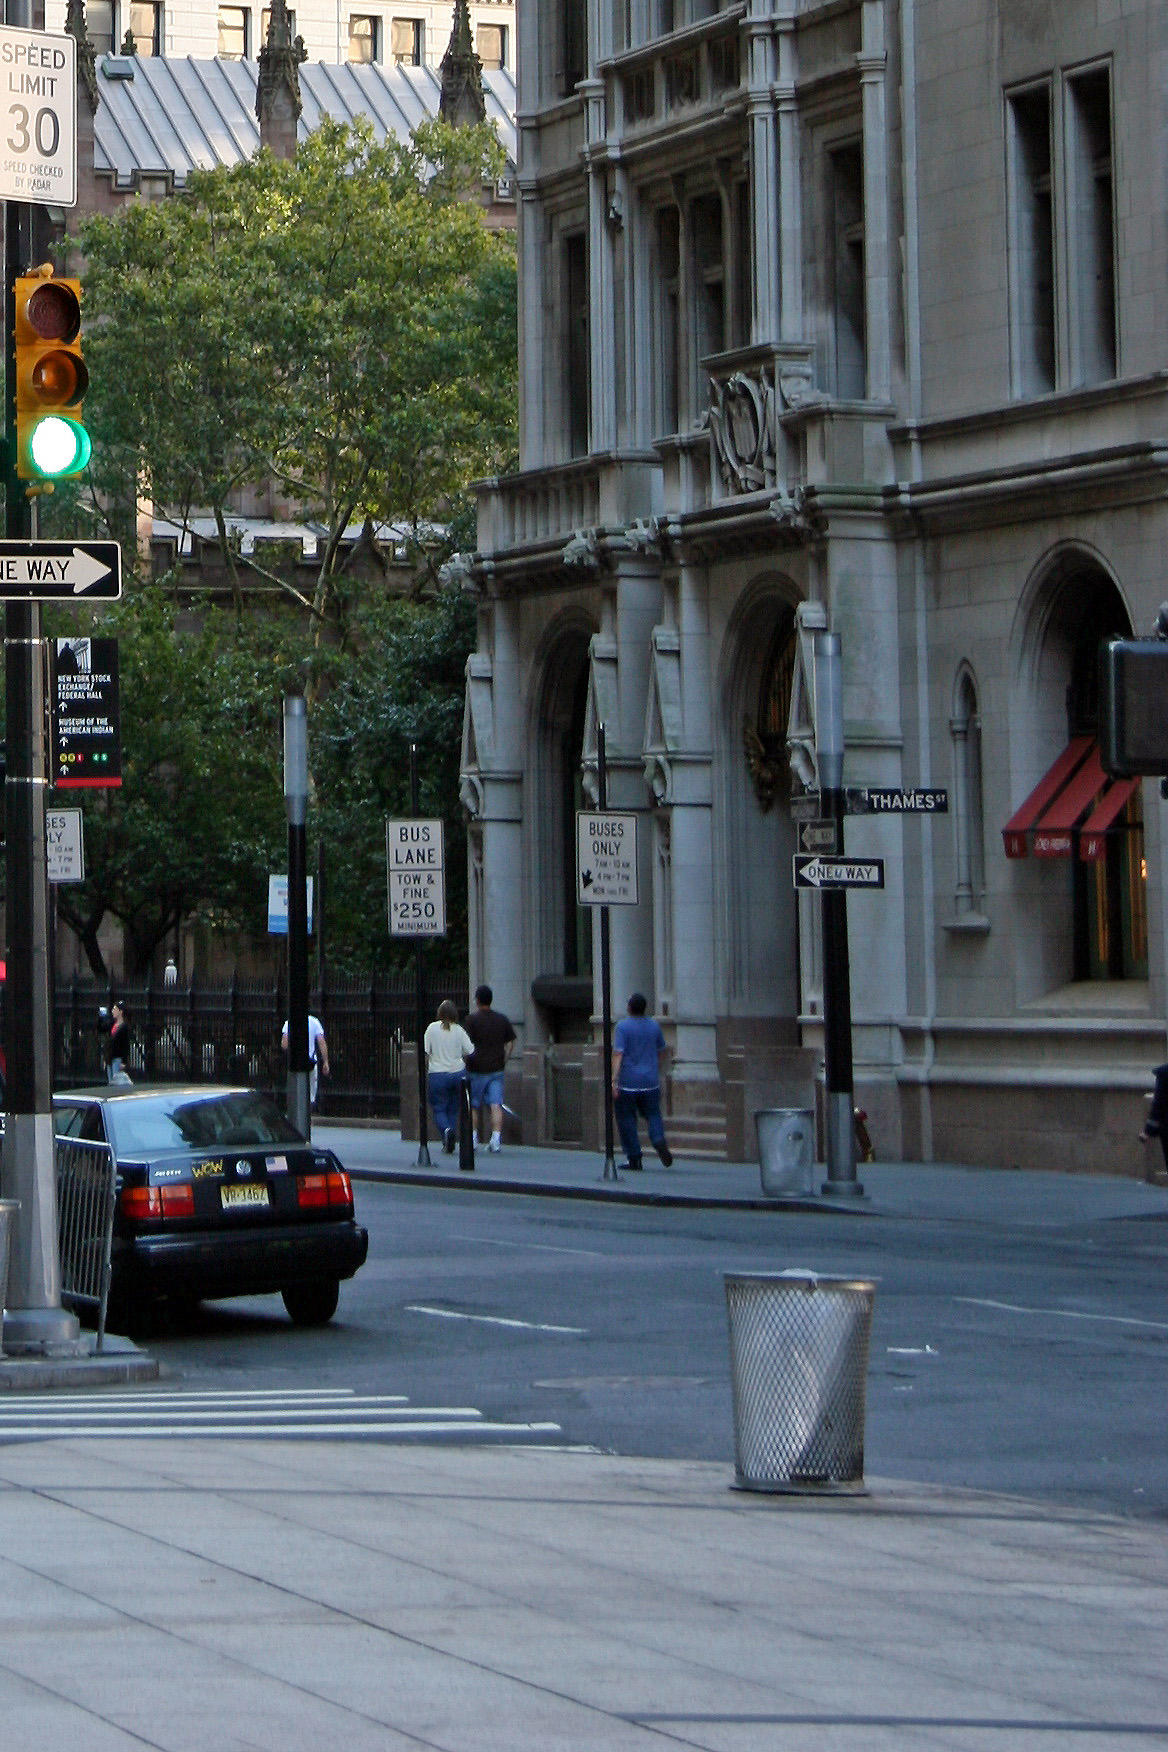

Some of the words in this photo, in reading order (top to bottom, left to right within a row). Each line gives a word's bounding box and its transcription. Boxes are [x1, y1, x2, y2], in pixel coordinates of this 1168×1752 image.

[1, 42, 66, 70] SPEED
[8, 72, 58, 97] LIMIT
[6, 103, 60, 157] 30
[3, 160, 27, 173] SPEED
[29, 164, 64, 178] CHECKED
[15, 176, 24, 189] BY
[27, 179, 51, 192] RADAR
[27, 560, 70, 580] WAY
[870, 794, 935, 809] THAMES
[399, 827, 430, 842] BUS
[589, 821, 625, 838] BUSES
[395, 848, 435, 864] LANE
[592, 840, 621, 856] ONLY
[397, 874, 422, 885] TOW
[426, 874, 435, 885] &
[808, 865, 834, 879] ONE
[845, 867, 873, 881] WAY
[403, 888, 430, 899] FINE
[397, 921, 438, 930] MINIMUM
